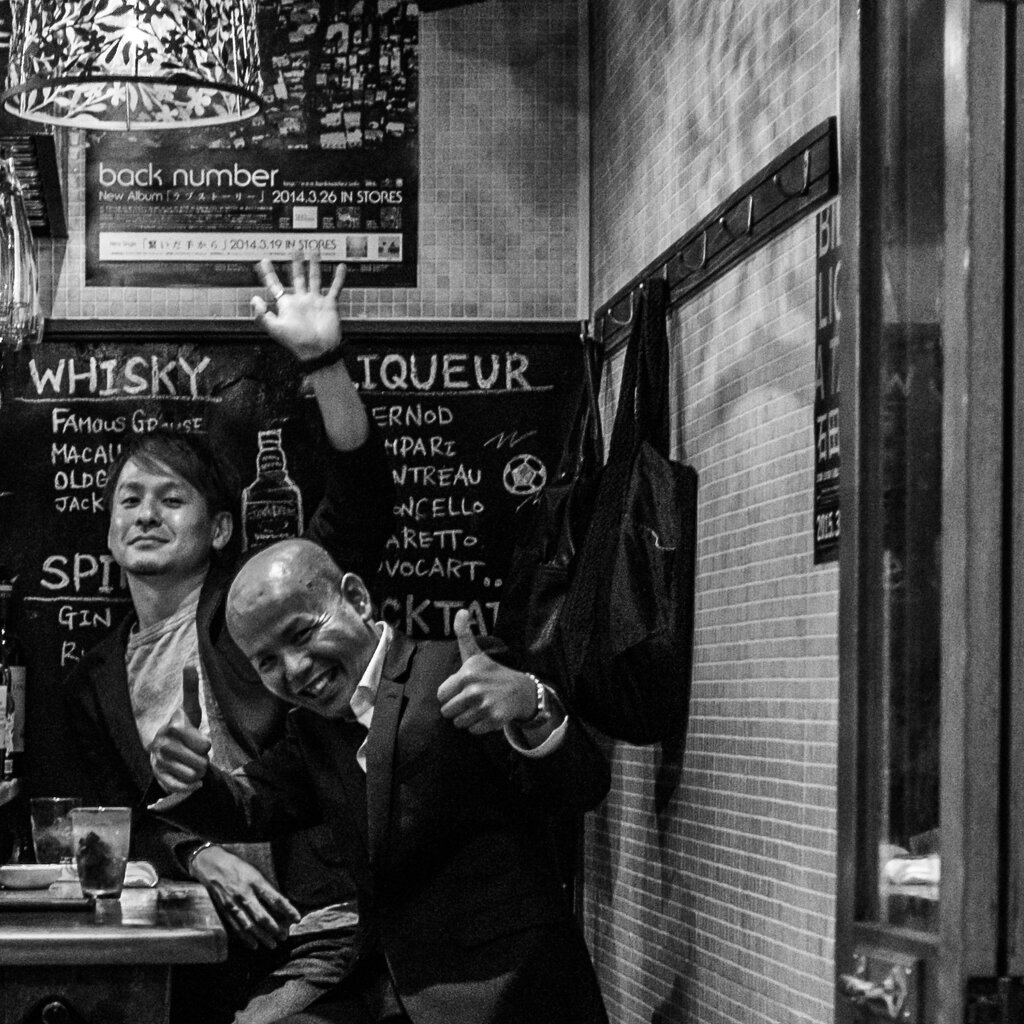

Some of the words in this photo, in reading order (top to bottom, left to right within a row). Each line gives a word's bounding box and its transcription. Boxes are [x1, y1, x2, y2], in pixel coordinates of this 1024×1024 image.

[99, 162, 163, 187] back
[172, 162, 279, 187] number
[98, 190, 124, 202] New
[127, 190, 163, 202] Album
[272, 190, 337, 203] 2014.3.26
[341, 191, 353, 203] IN
[357, 191, 403, 203] STORES
[28, 355, 211, 400] WHISKY
[353, 351, 533, 391] IQUEUR
[51, 407, 126, 434] FAMOUS
[54, 491, 105, 514] JACK
[58, 605, 112, 631] GIN
